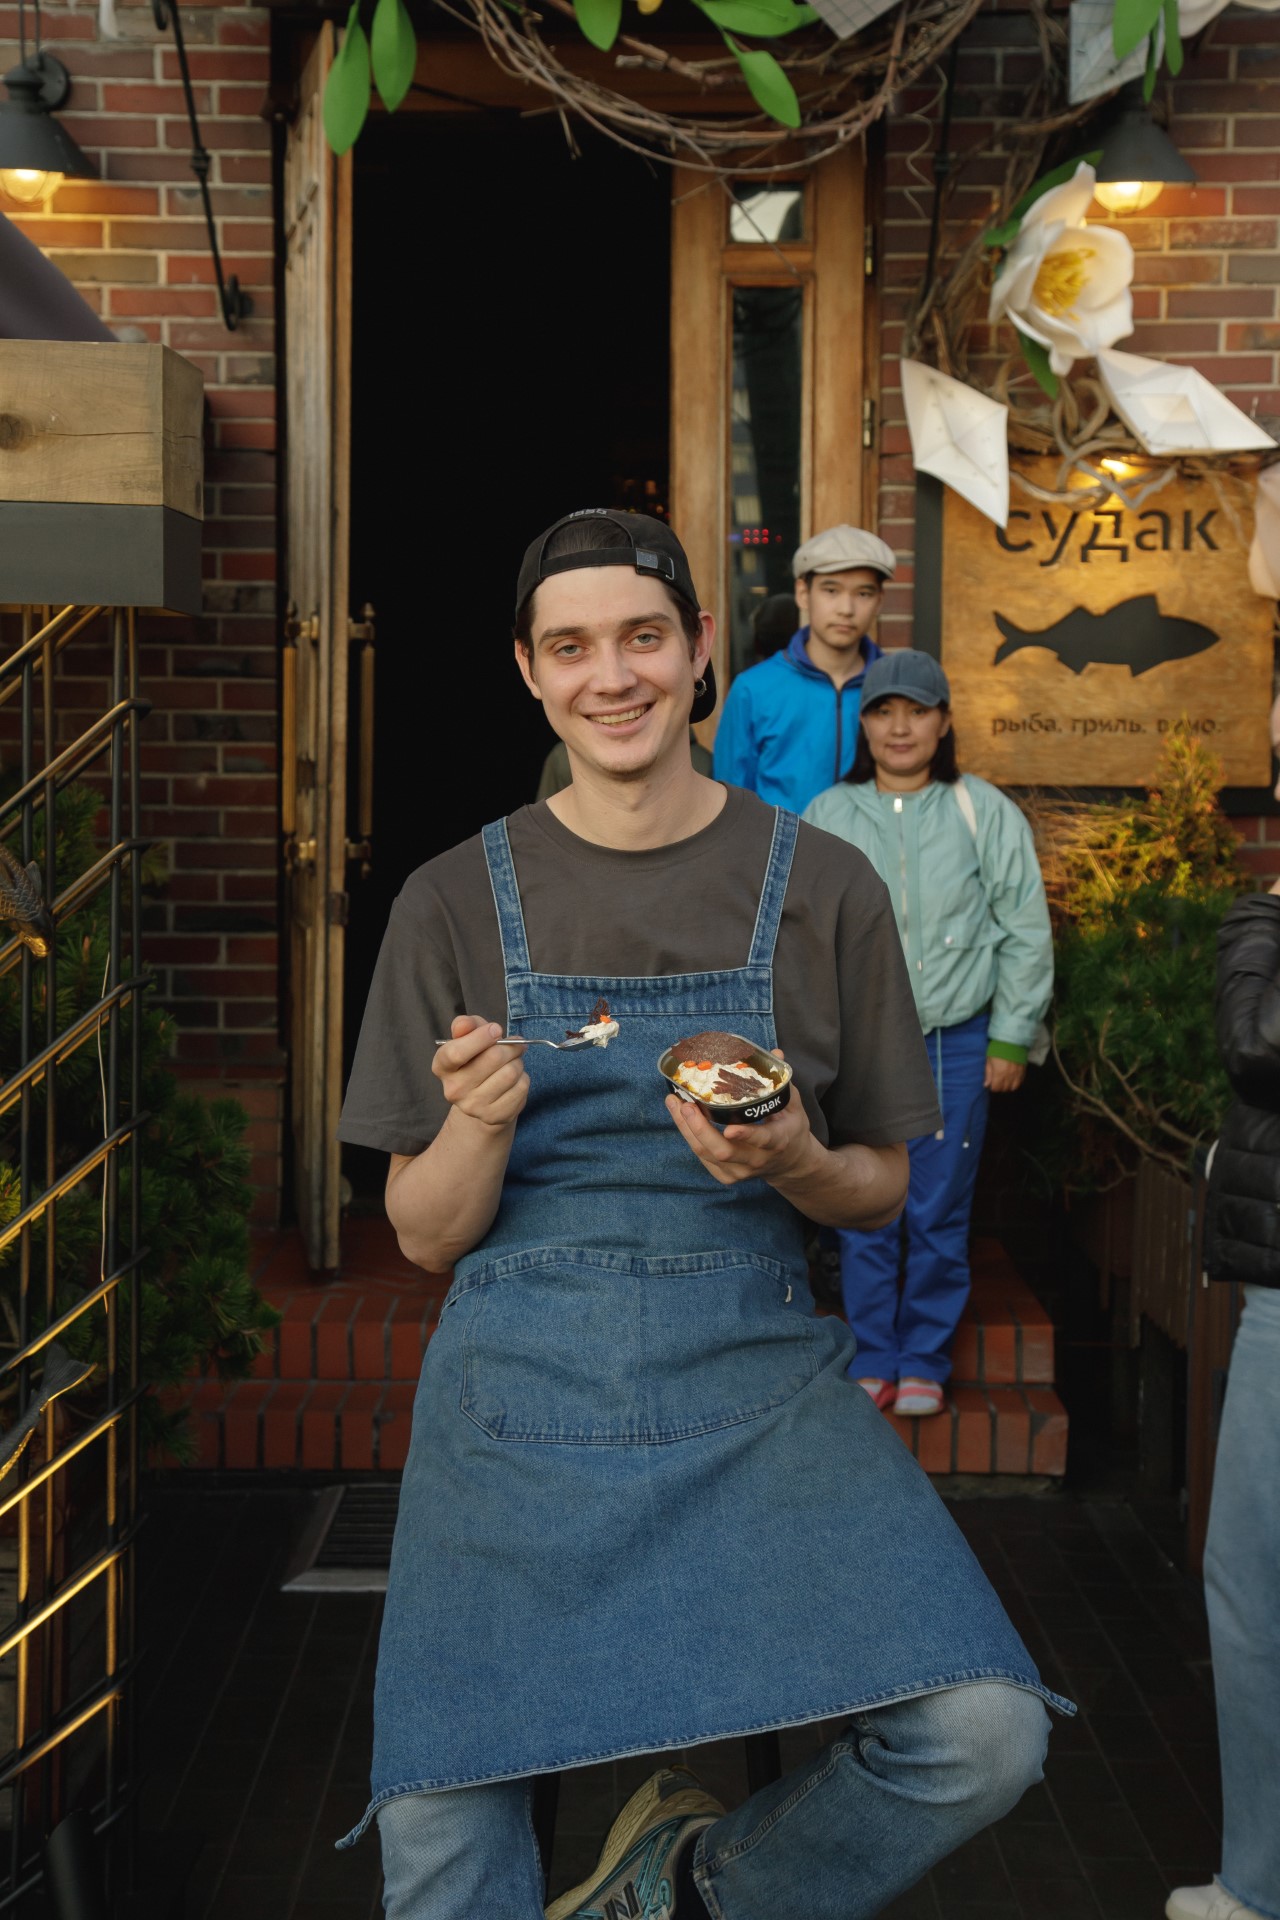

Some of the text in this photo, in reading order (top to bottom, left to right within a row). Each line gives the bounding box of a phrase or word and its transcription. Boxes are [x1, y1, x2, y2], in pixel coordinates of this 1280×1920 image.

[995, 508, 1220, 567] судак
[991, 712, 1063, 737] рыба.
[1071, 717, 1147, 737] гриль.
[744, 1096, 781, 1118] судак
